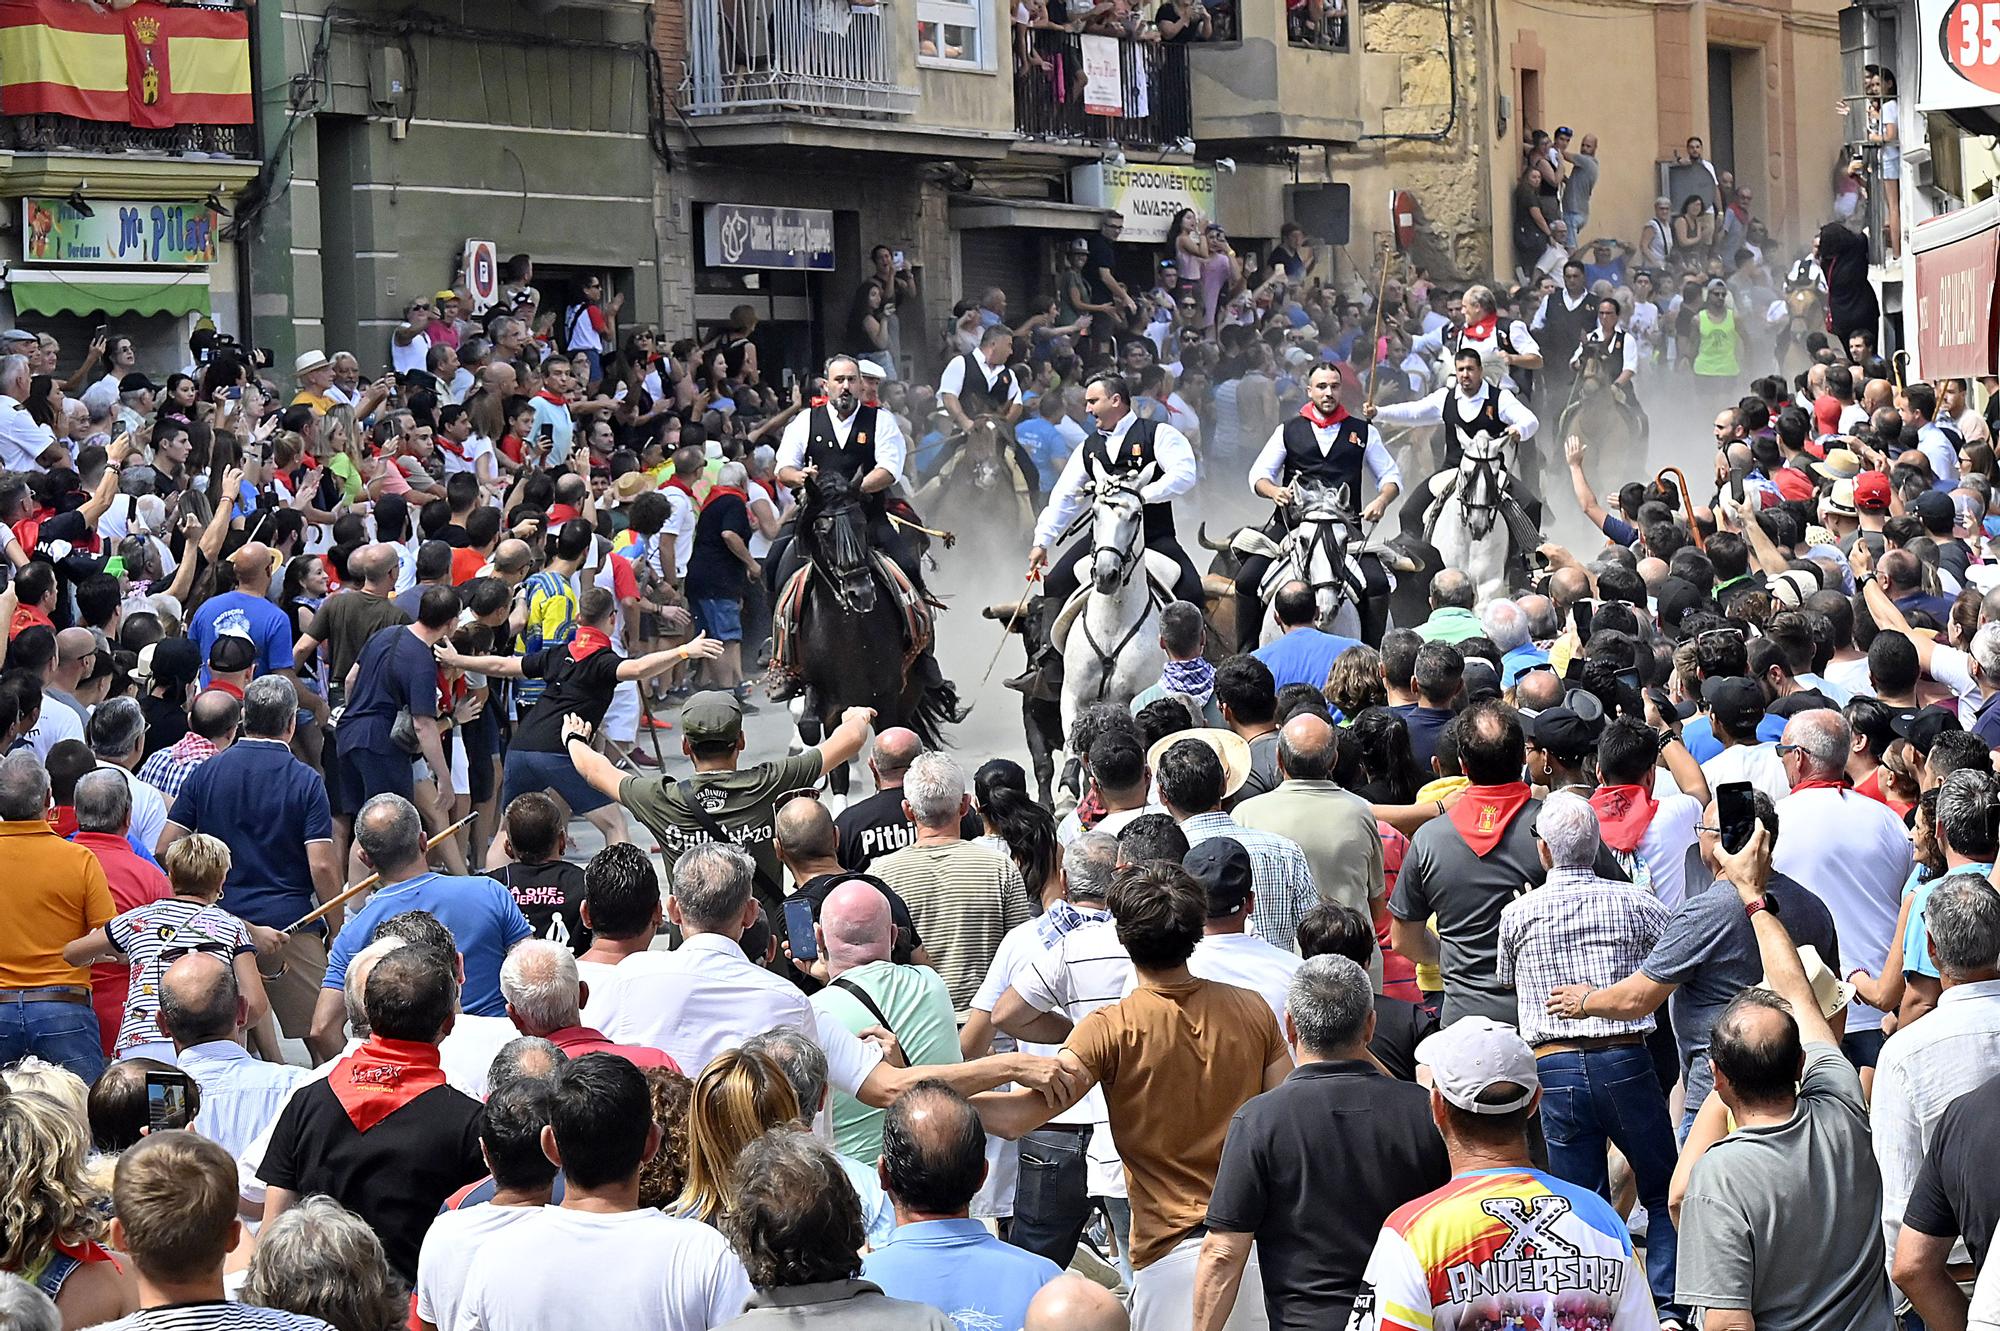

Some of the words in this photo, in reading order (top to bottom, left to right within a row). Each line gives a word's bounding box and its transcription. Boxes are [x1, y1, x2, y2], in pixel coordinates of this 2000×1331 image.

[151, 205, 210, 262] Pilar
[860, 821, 919, 856] Pitbi
[1481, 1195, 1581, 1261] X
[1447, 1256, 1623, 1304] ANIVERSARI
